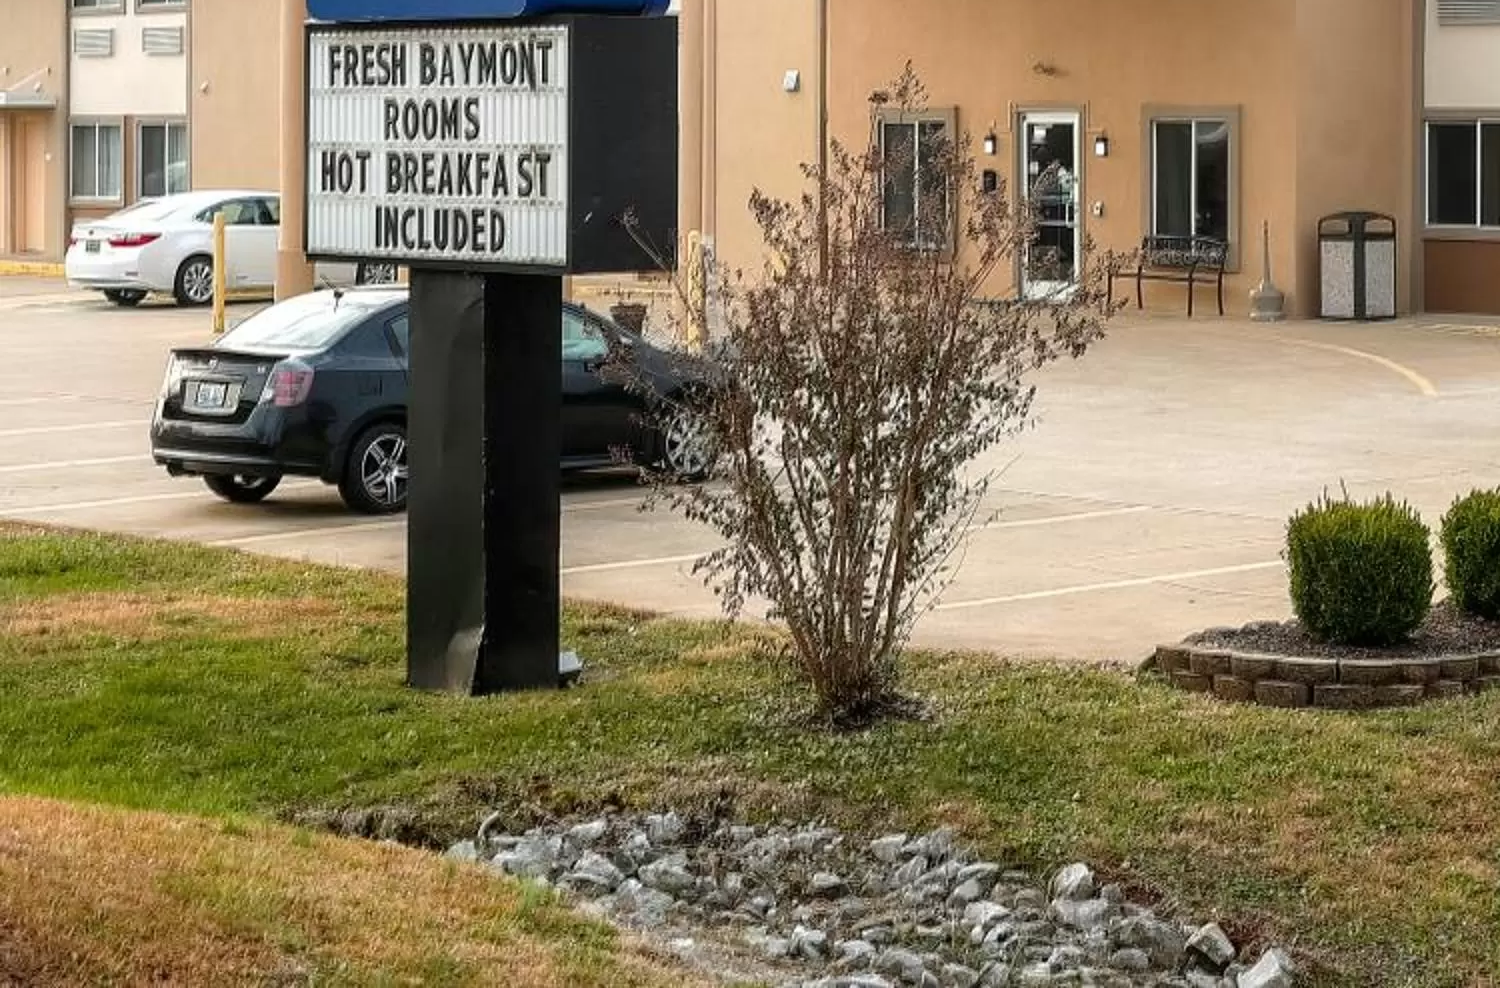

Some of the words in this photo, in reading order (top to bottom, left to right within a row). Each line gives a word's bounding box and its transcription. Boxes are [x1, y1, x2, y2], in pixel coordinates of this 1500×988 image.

[328, 43, 407, 86] FRESH
[419, 39, 552, 90] BAYMONT
[384, 97, 480, 140] ROOMS
[321, 150, 371, 193] HOT
[386, 151, 551, 197] BREAKFAST
[375, 205, 506, 253] INCLUDED
